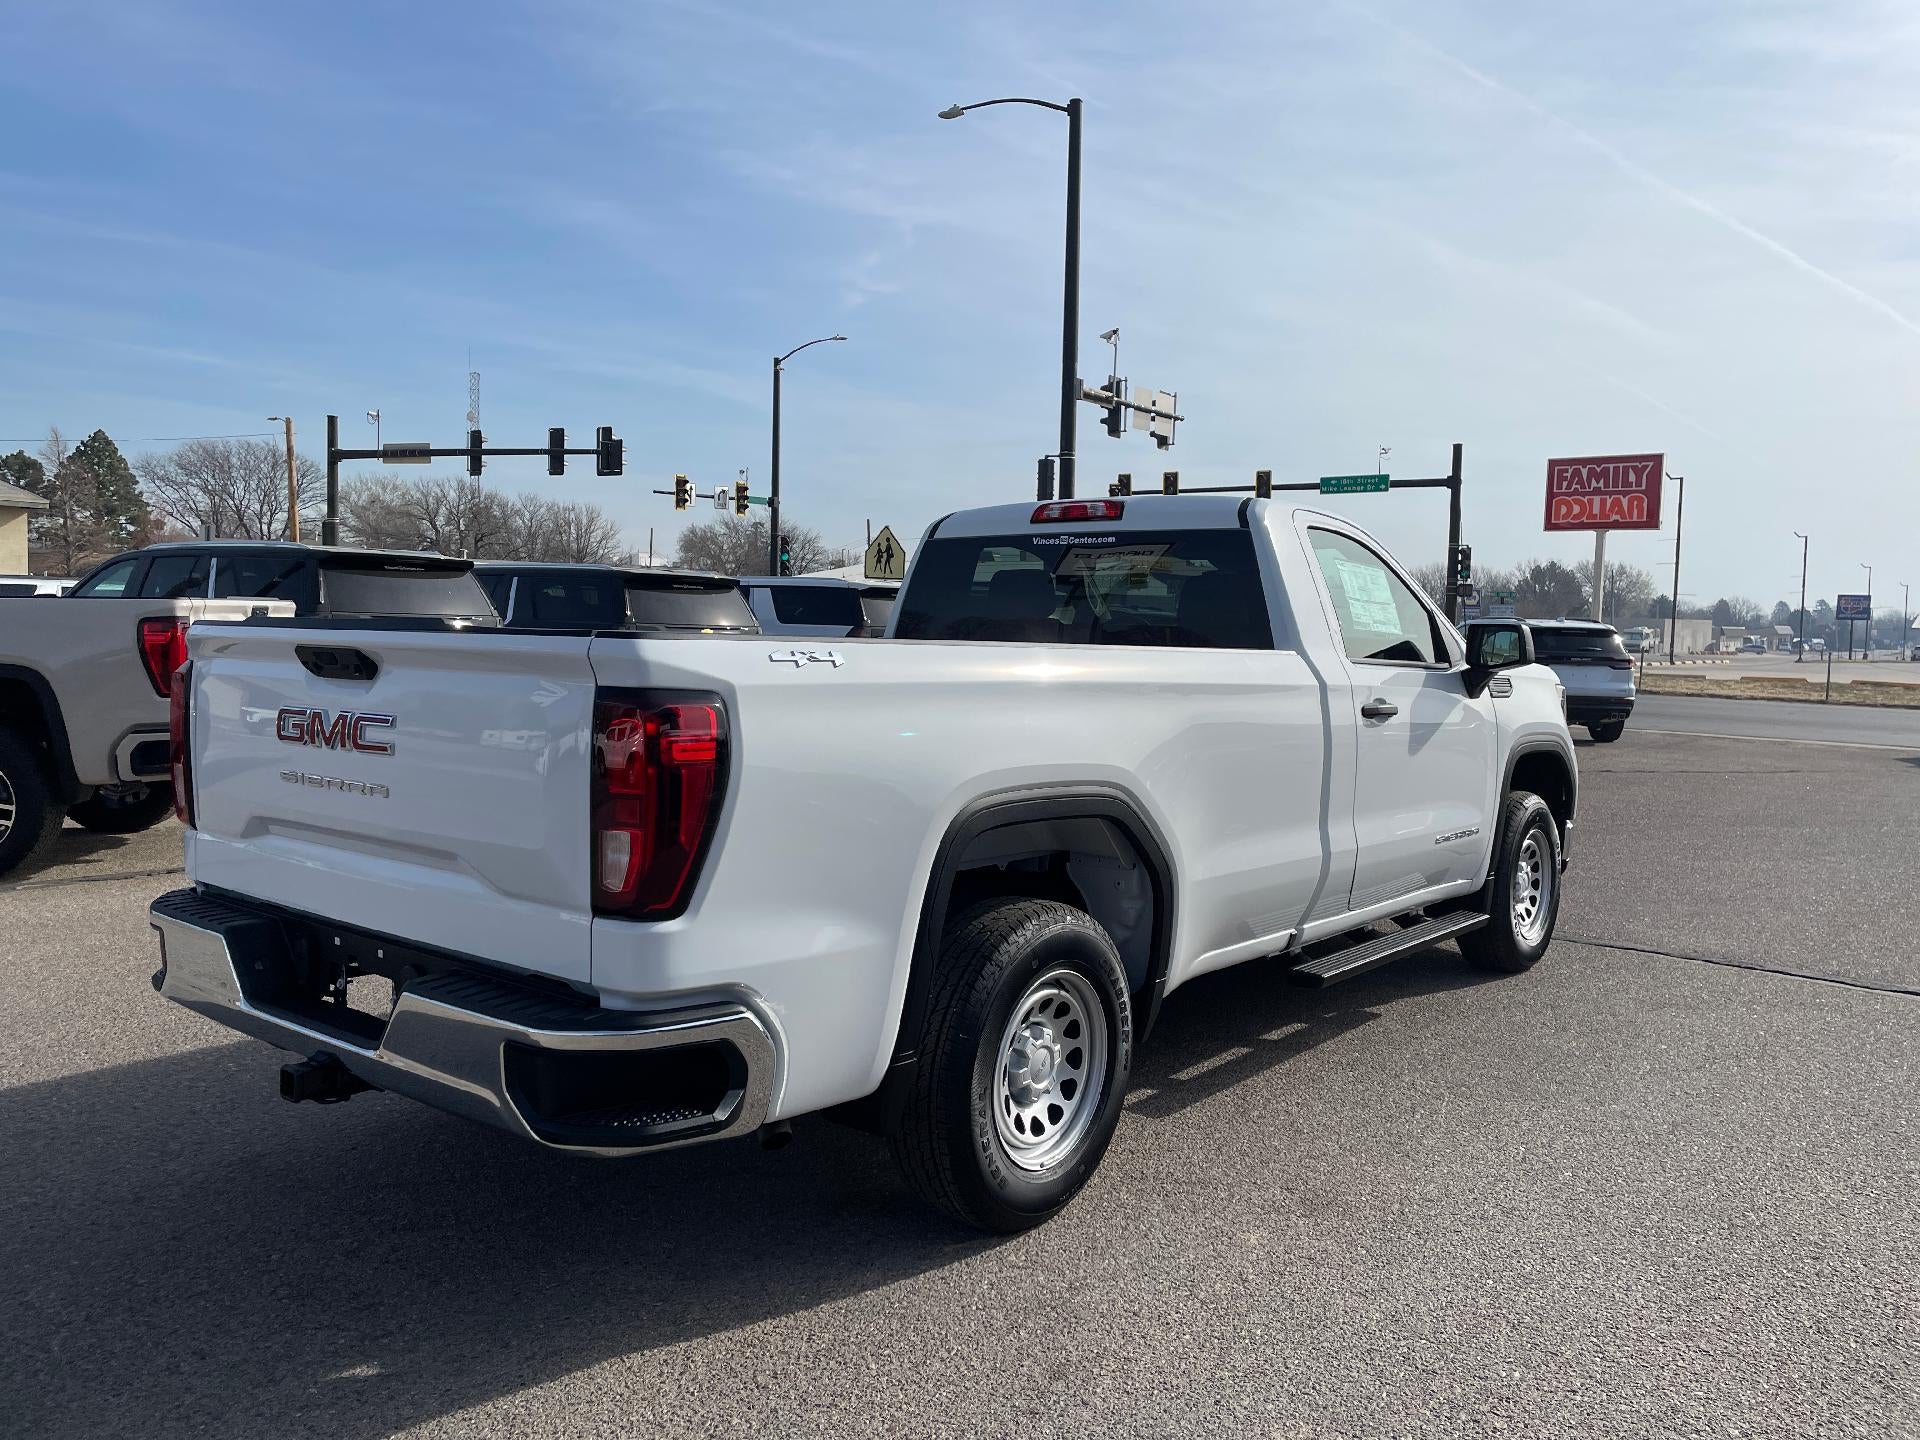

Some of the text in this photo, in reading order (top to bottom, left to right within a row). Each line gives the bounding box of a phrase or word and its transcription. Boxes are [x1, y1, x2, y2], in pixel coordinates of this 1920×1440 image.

[1553, 462, 1654, 492] FAMILY
[1551, 493, 1648, 523] DOLLAR
[276, 705, 398, 756] GMC
[279, 769, 390, 798] SIERRA
[978, 1086, 1008, 1190] GENERAL
